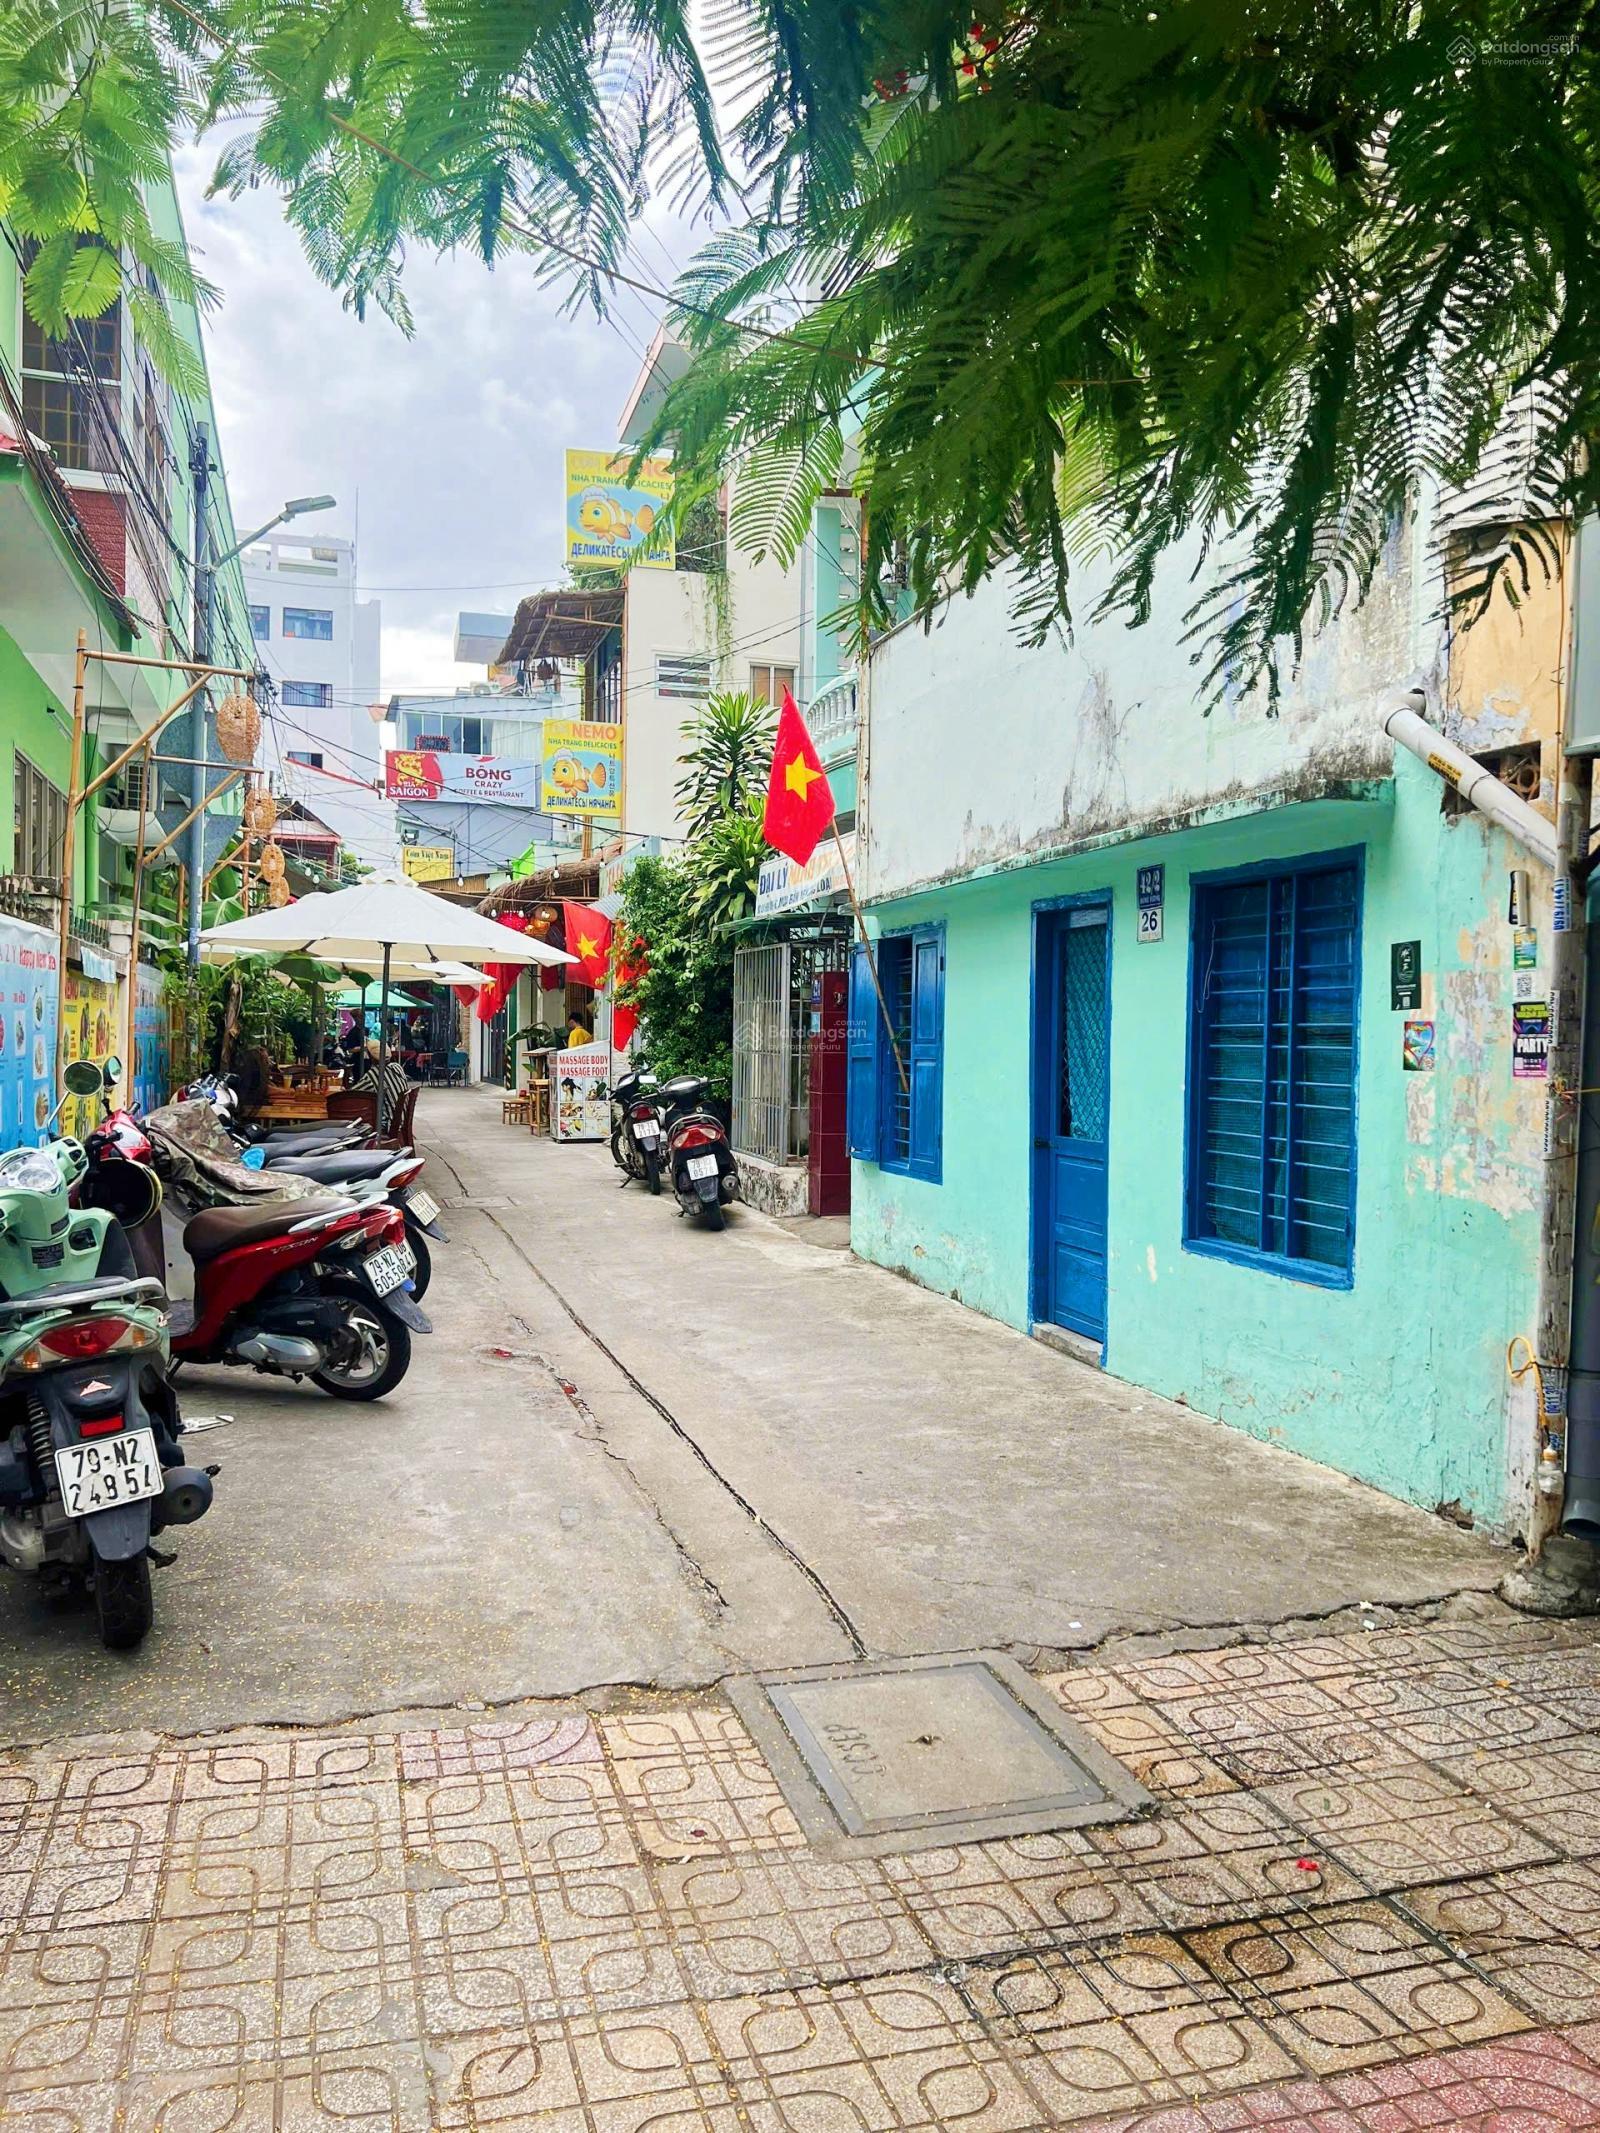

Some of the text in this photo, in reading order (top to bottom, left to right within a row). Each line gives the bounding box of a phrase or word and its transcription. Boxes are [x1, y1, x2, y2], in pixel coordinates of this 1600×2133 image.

[572, 723, 617, 740] NEMO
[562, 738, 582, 746] TRANG
[583, 740, 617, 749] DELICACIES
[465, 765, 512, 781] BÔNG
[474, 780, 503, 789] CRAZY
[389, 786, 429, 797] SAIGON
[484, 790, 525, 798] RESTAURANT
[1141, 911, 1158, 932] 26
[1517, 1038, 1548, 1054] PARTY
[559, 1055, 608, 1065] MASSAGE BODY
[560, 1067, 608, 1077] MASSAGE FOOT
[369, 1251, 396, 1276] 79-N2
[71, 1437, 142, 1479] 79-N2
